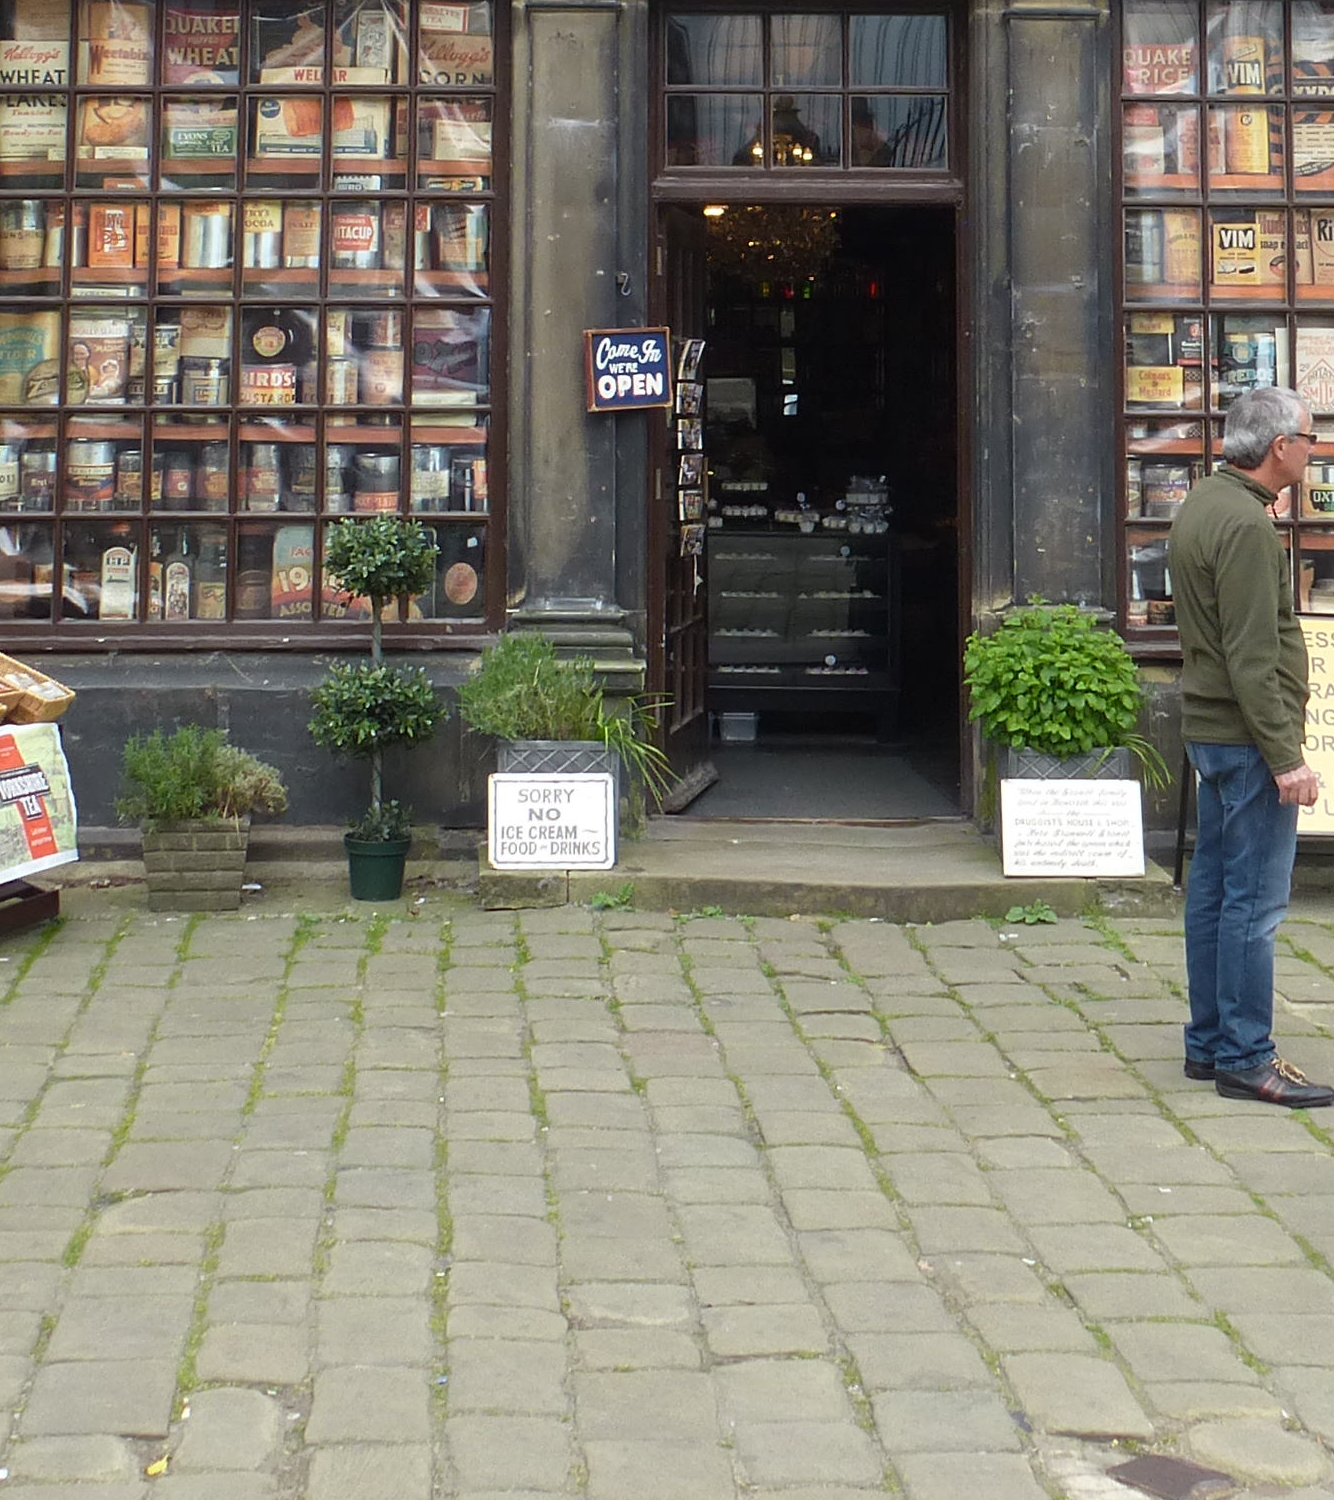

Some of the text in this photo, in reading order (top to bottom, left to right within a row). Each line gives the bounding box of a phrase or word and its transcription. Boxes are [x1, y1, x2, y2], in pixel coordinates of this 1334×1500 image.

[167, 16, 240, 35] QUAKE
[4, 45, 61, 63] Kellogg's
[1124, 49, 1193, 66] QUAKE
[0, 69, 66, 86] WHEAT
[419, 71, 485, 85] CORN
[1139, 67, 1190, 84] RICE
[1228, 62, 1260, 85] VIM
[244, 220, 274, 228] OCOA
[1221, 230, 1253, 248] VIM
[596, 337, 662, 370] Come In
[609, 363, 638, 374] WE'RE
[242, 372, 292, 387] BIRD'S
[598, 373, 663, 399] OPEN
[279, 601, 346, 617] ASSOTED
[518, 789, 575, 804] SORRY
[19, 795, 42, 816] TEA
[528, 808, 561, 821] NO
[501, 825, 577, 840] ICE CREAM
[501, 841, 601, 856] FOOD DRINKS
